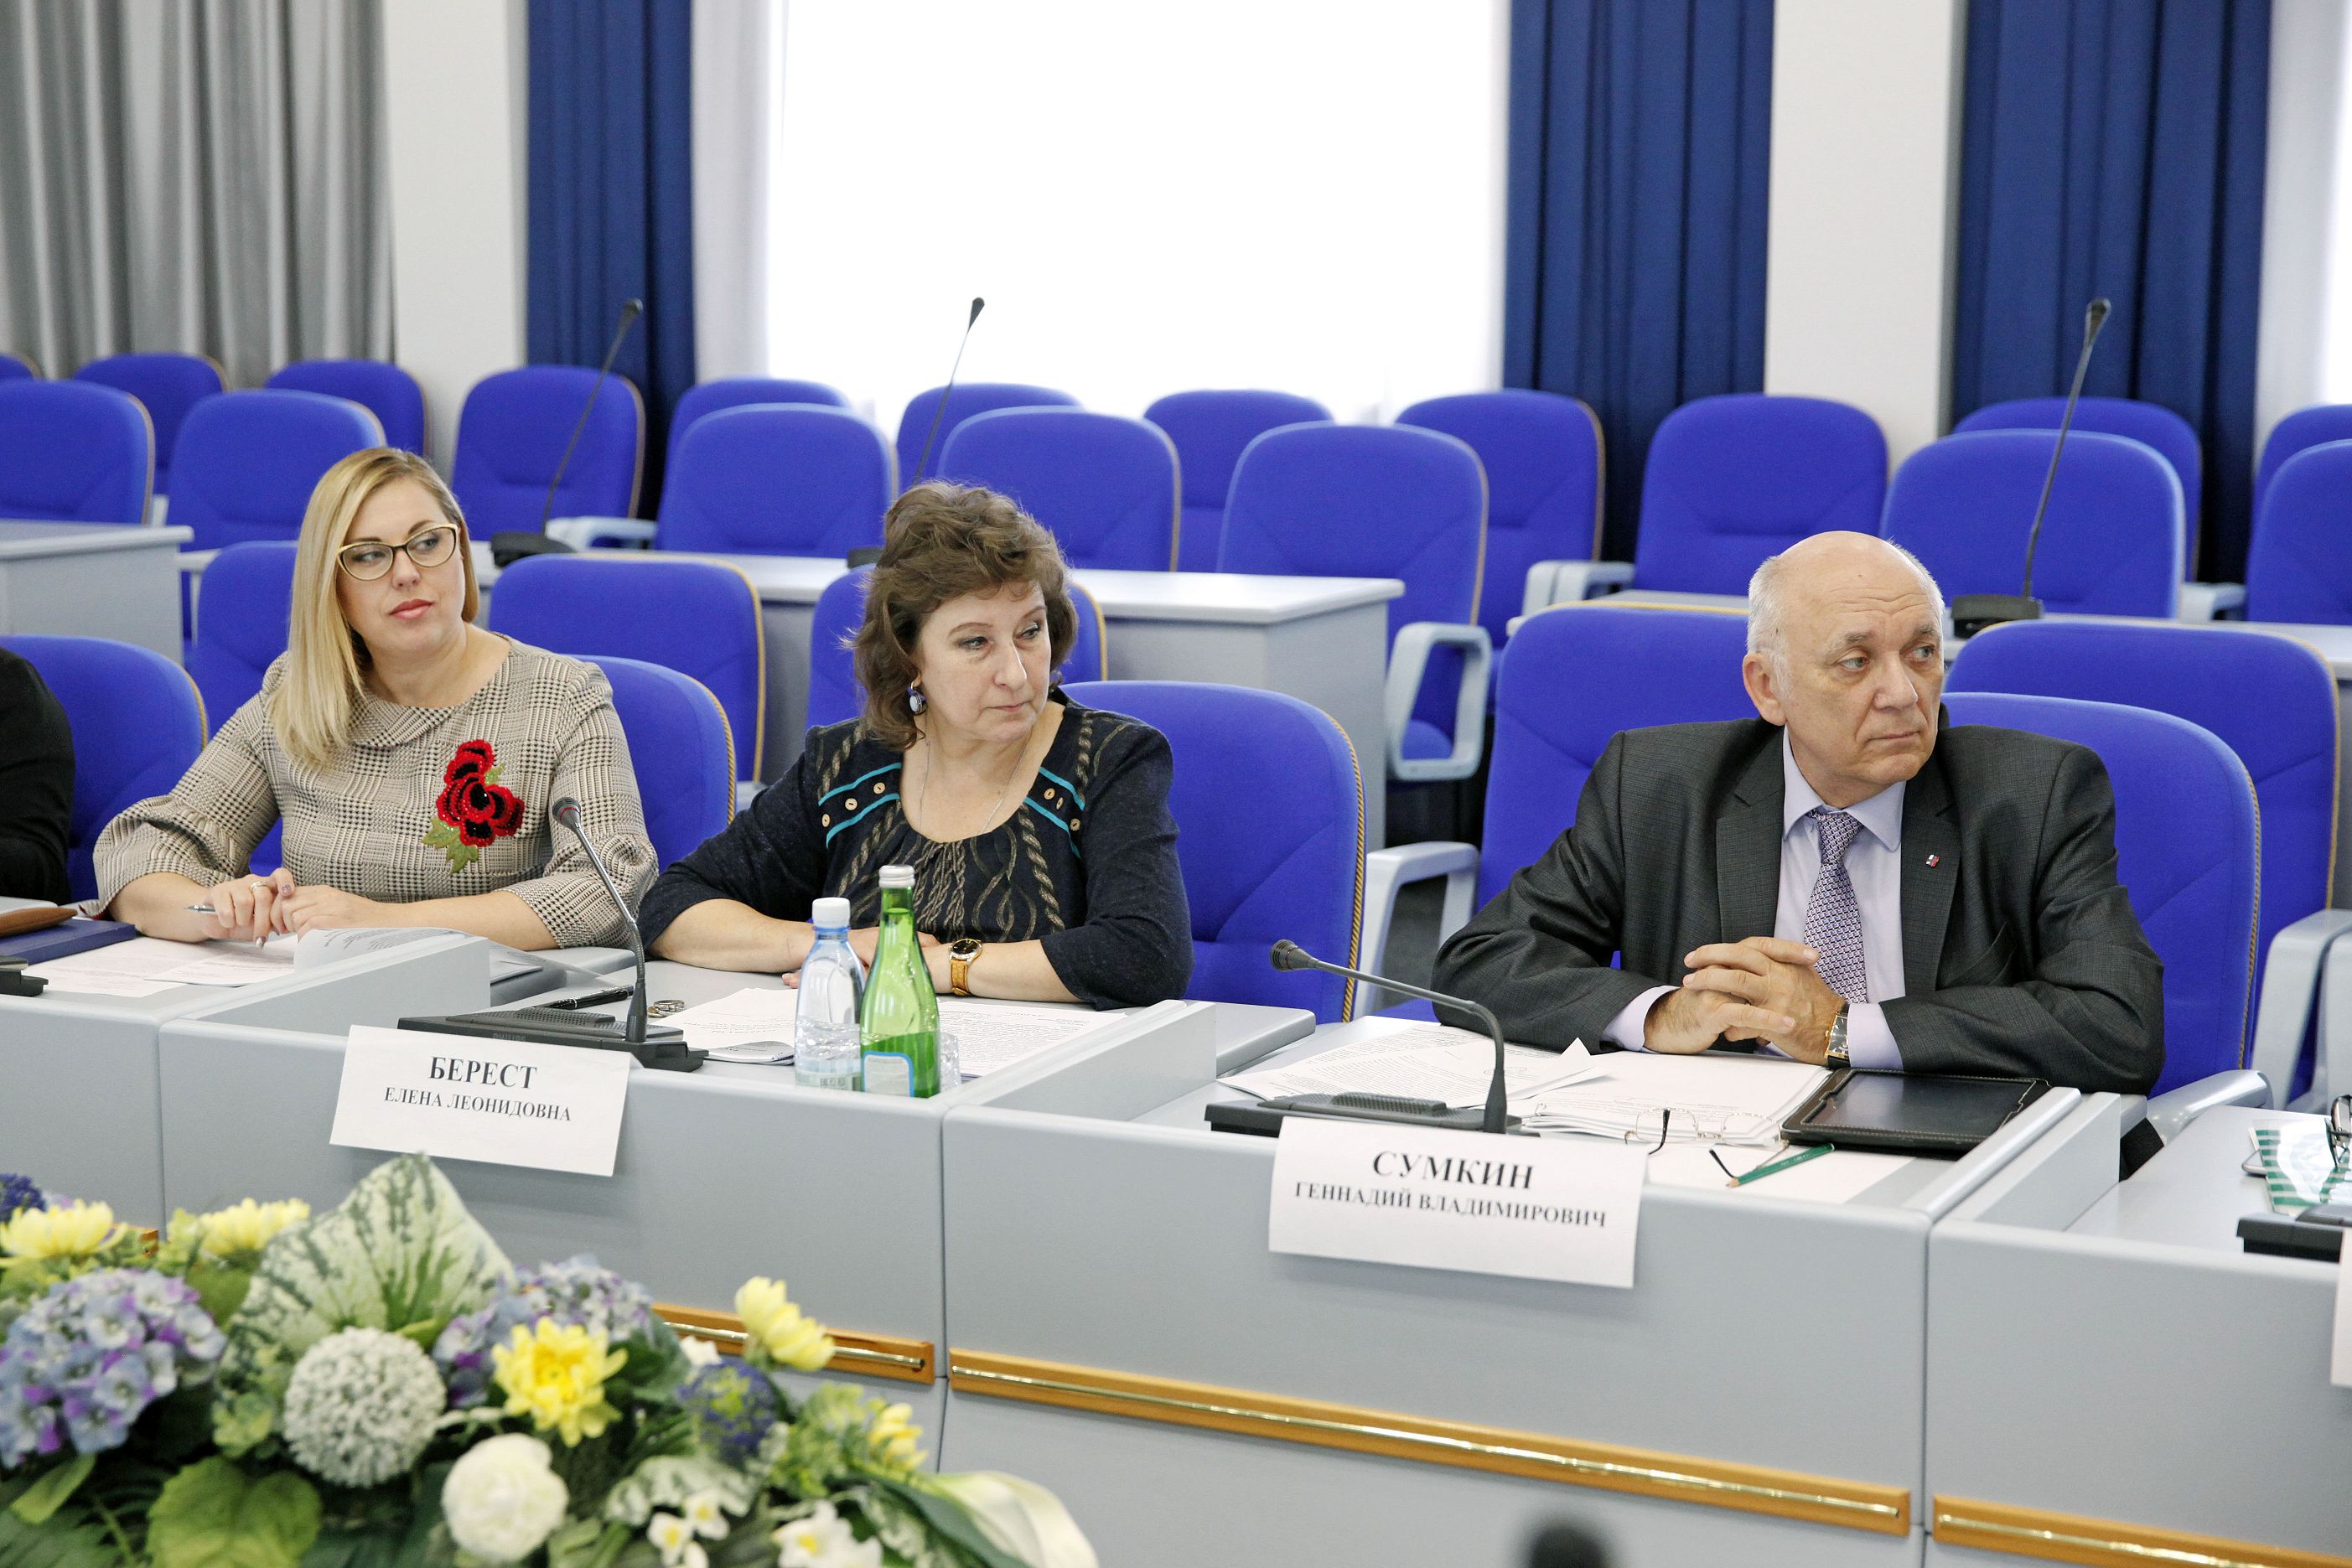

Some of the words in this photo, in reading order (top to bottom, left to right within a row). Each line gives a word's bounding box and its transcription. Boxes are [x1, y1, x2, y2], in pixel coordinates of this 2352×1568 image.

[429, 1056, 537, 1089] БЕРЕСТ
[383, 1087, 442, 1107] ЕЛЕНА
[447, 1094, 571, 1121] ЛЕОНИДОВНА
[1372, 1151, 1534, 1189] СУМКИН
[1295, 1181, 1412, 1208] ГЕННАДИЙ
[1419, 1195, 1606, 1228] ВЛАДИМИРОВИЧ
